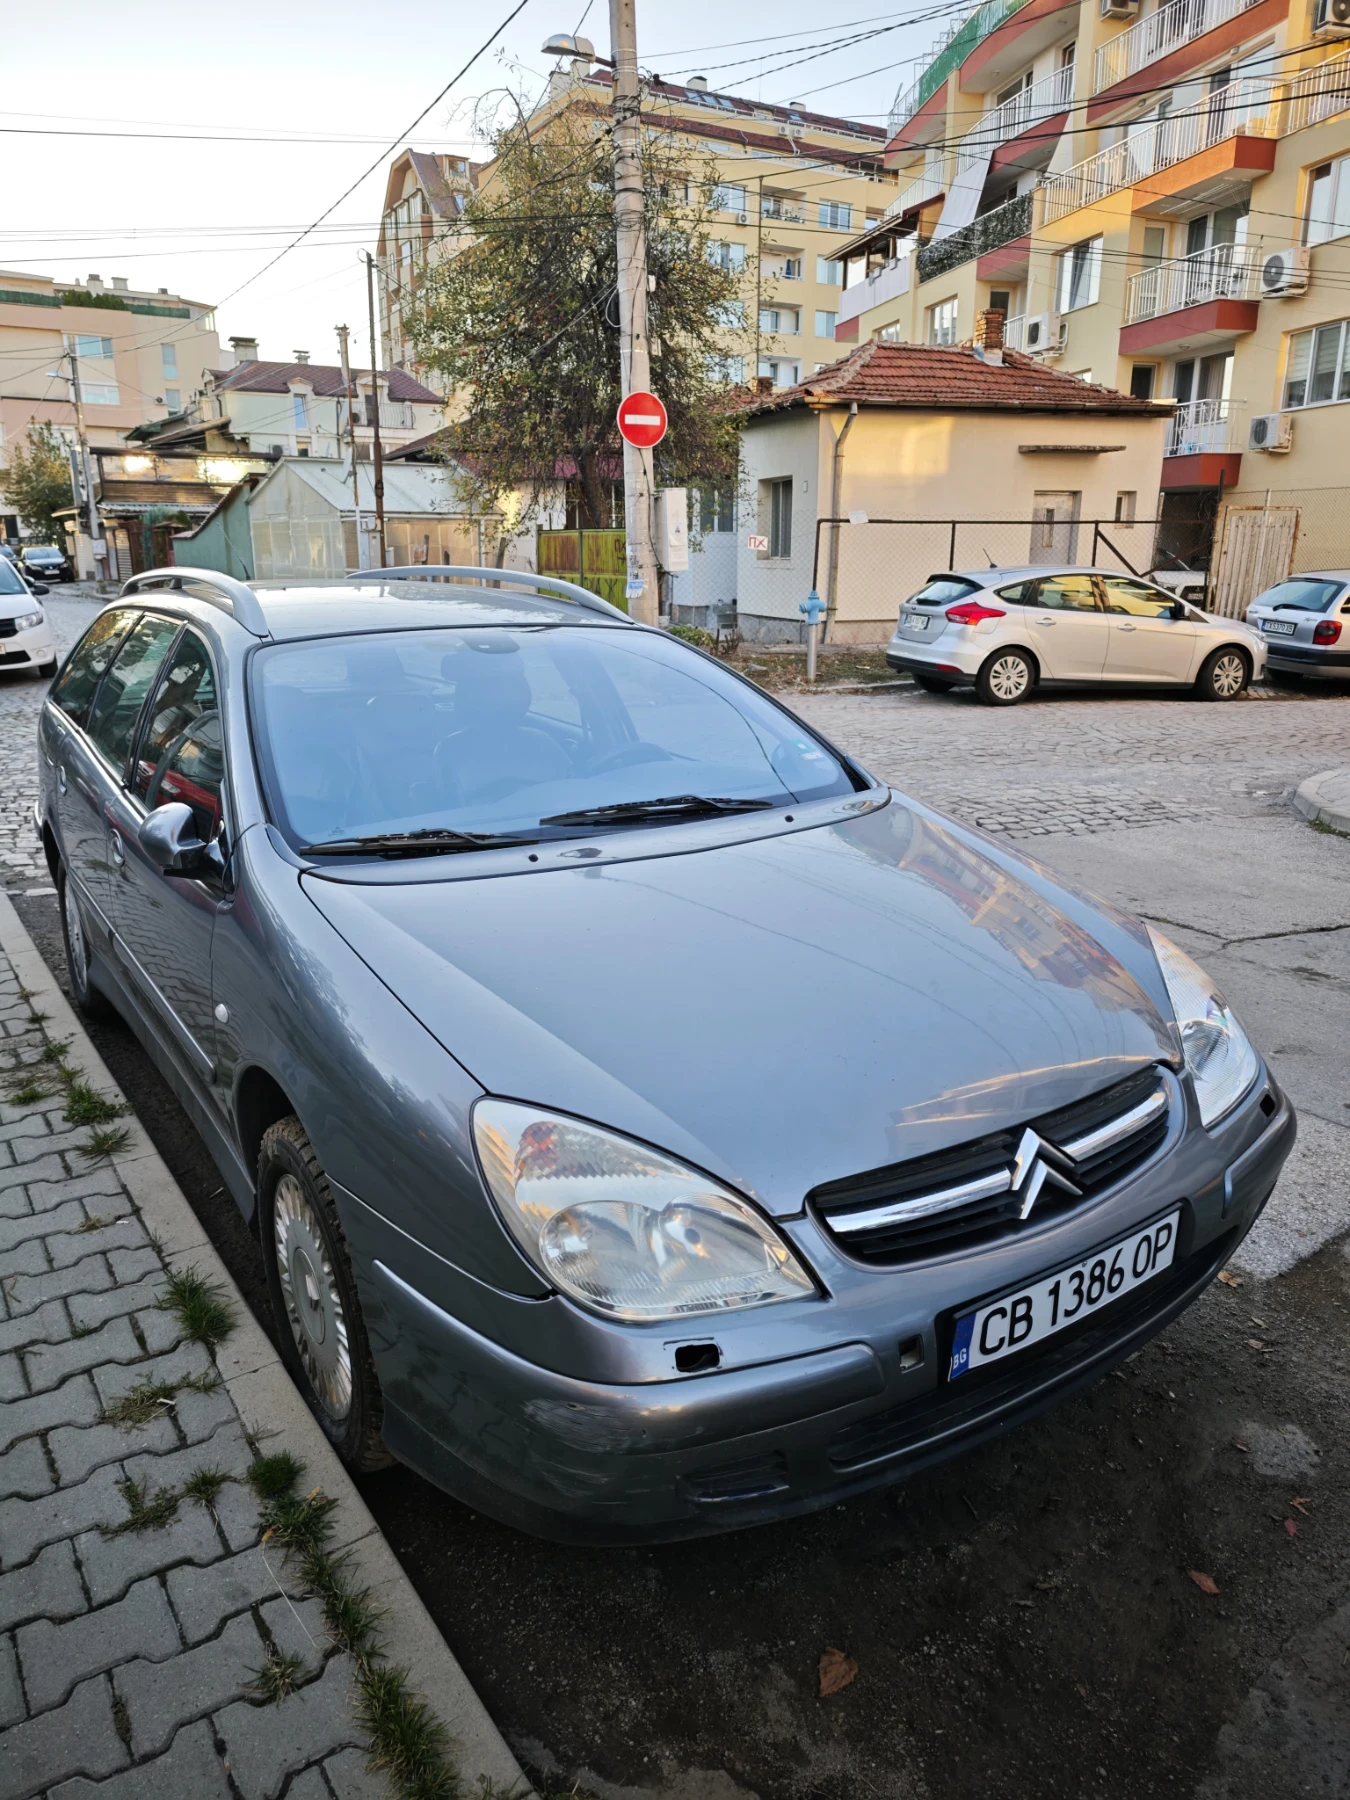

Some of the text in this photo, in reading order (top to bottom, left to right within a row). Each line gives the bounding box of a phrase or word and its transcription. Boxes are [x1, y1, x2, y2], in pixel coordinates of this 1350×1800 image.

[979, 1222, 1173, 1356] CB 1386 OP
[953, 1348, 967, 1369] BG
